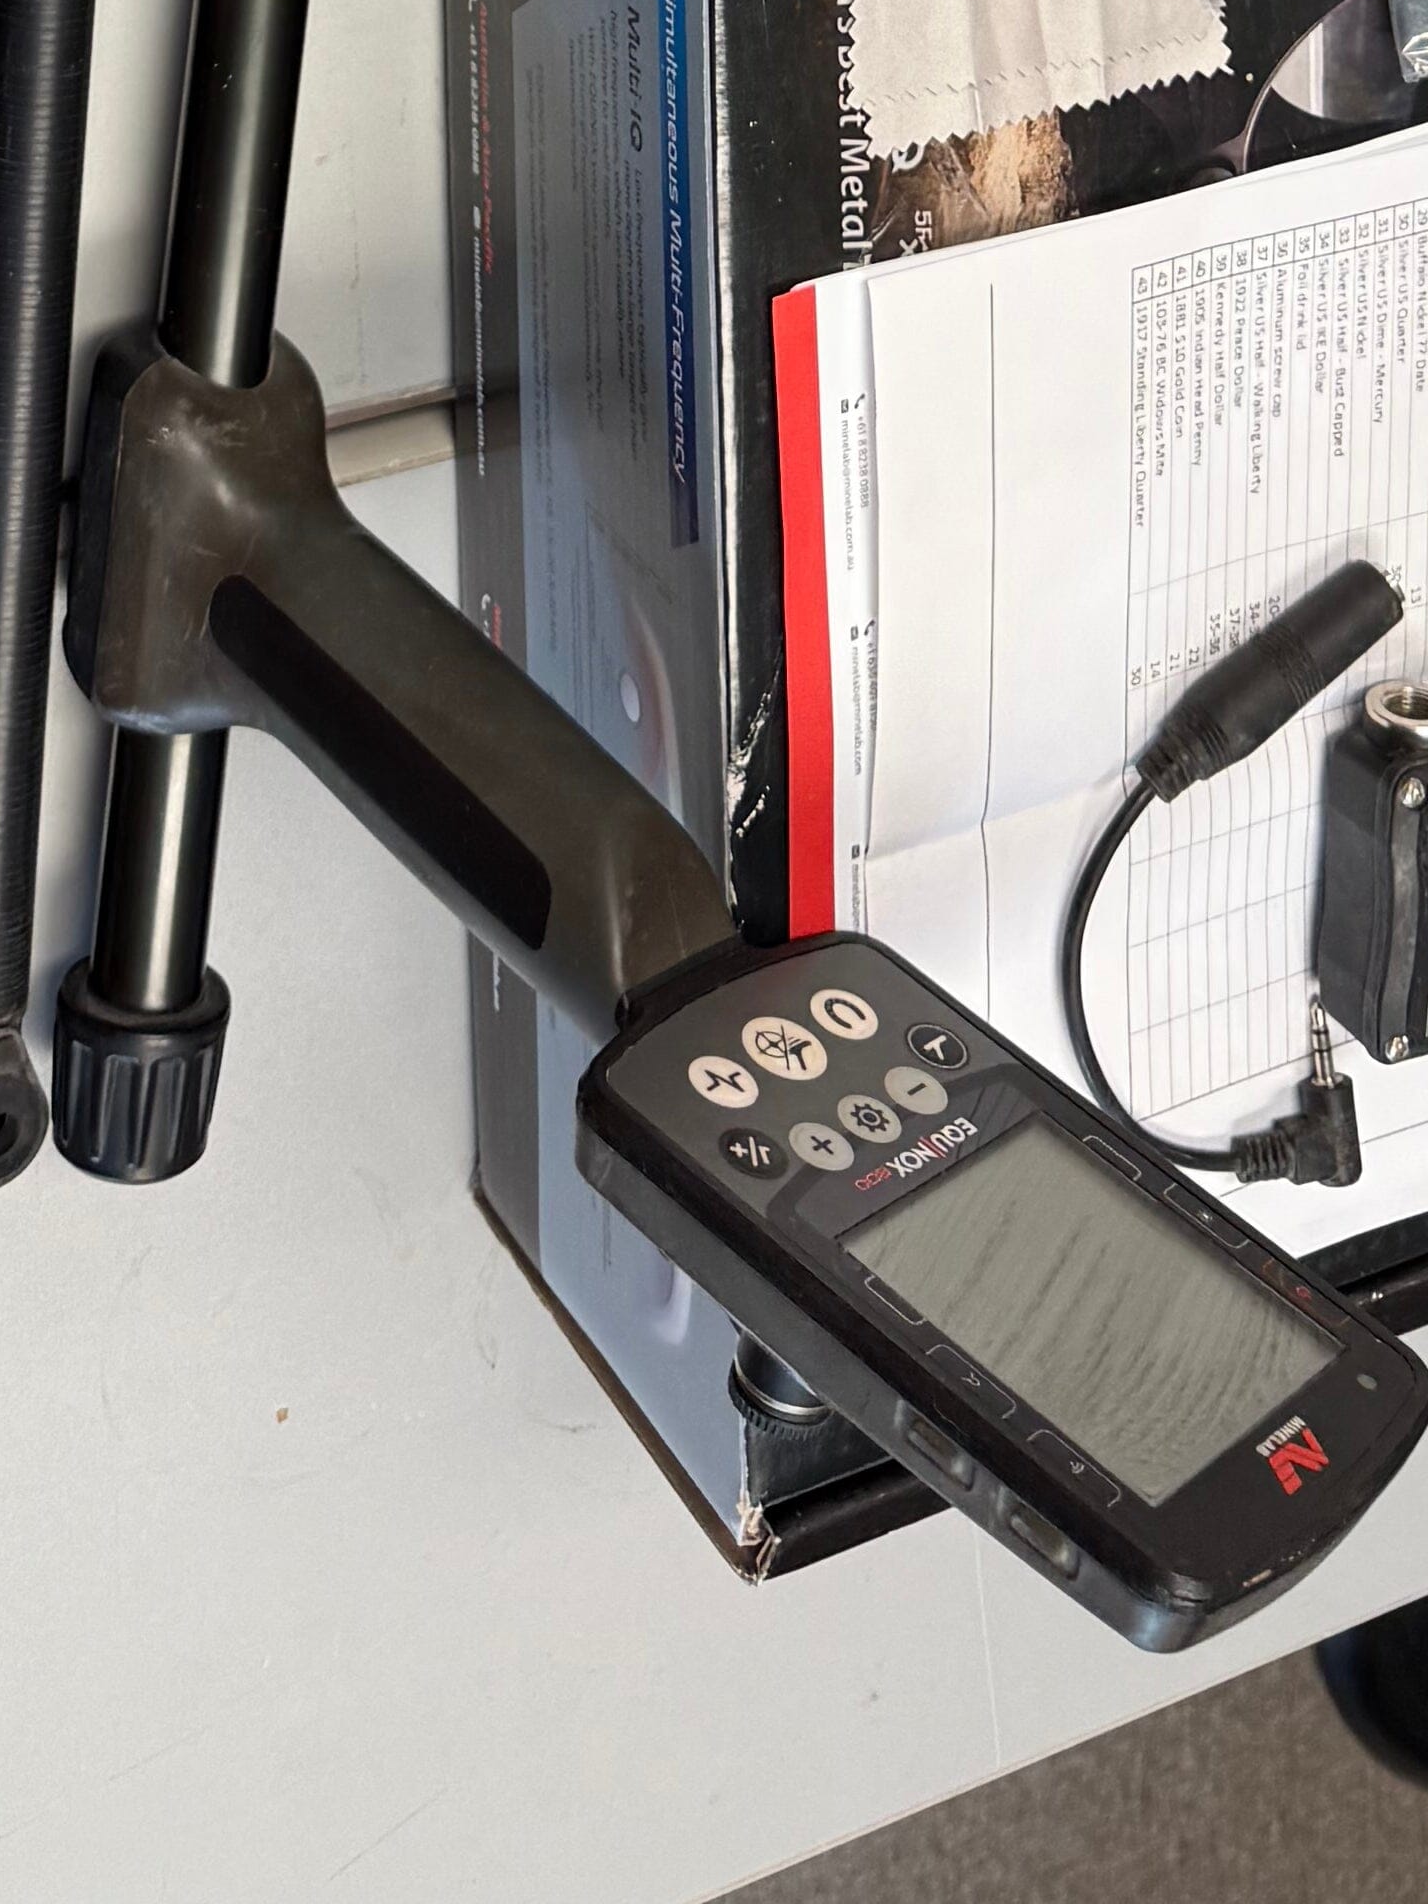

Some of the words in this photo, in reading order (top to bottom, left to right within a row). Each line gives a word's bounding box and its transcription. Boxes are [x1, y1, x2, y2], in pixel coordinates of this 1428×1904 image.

[840, 138, 873, 249] Metal
[1213, 282, 1226, 346] Kennedy
[665, 208, 688, 484] Multi-Frequency
[1173, 366, 1186, 401] Gold
[1133, 471, 1146, 527] Quarter
[885, 1117, 979, 1178] EQUINOX
[1255, 1414, 1306, 1458] MINELAB
